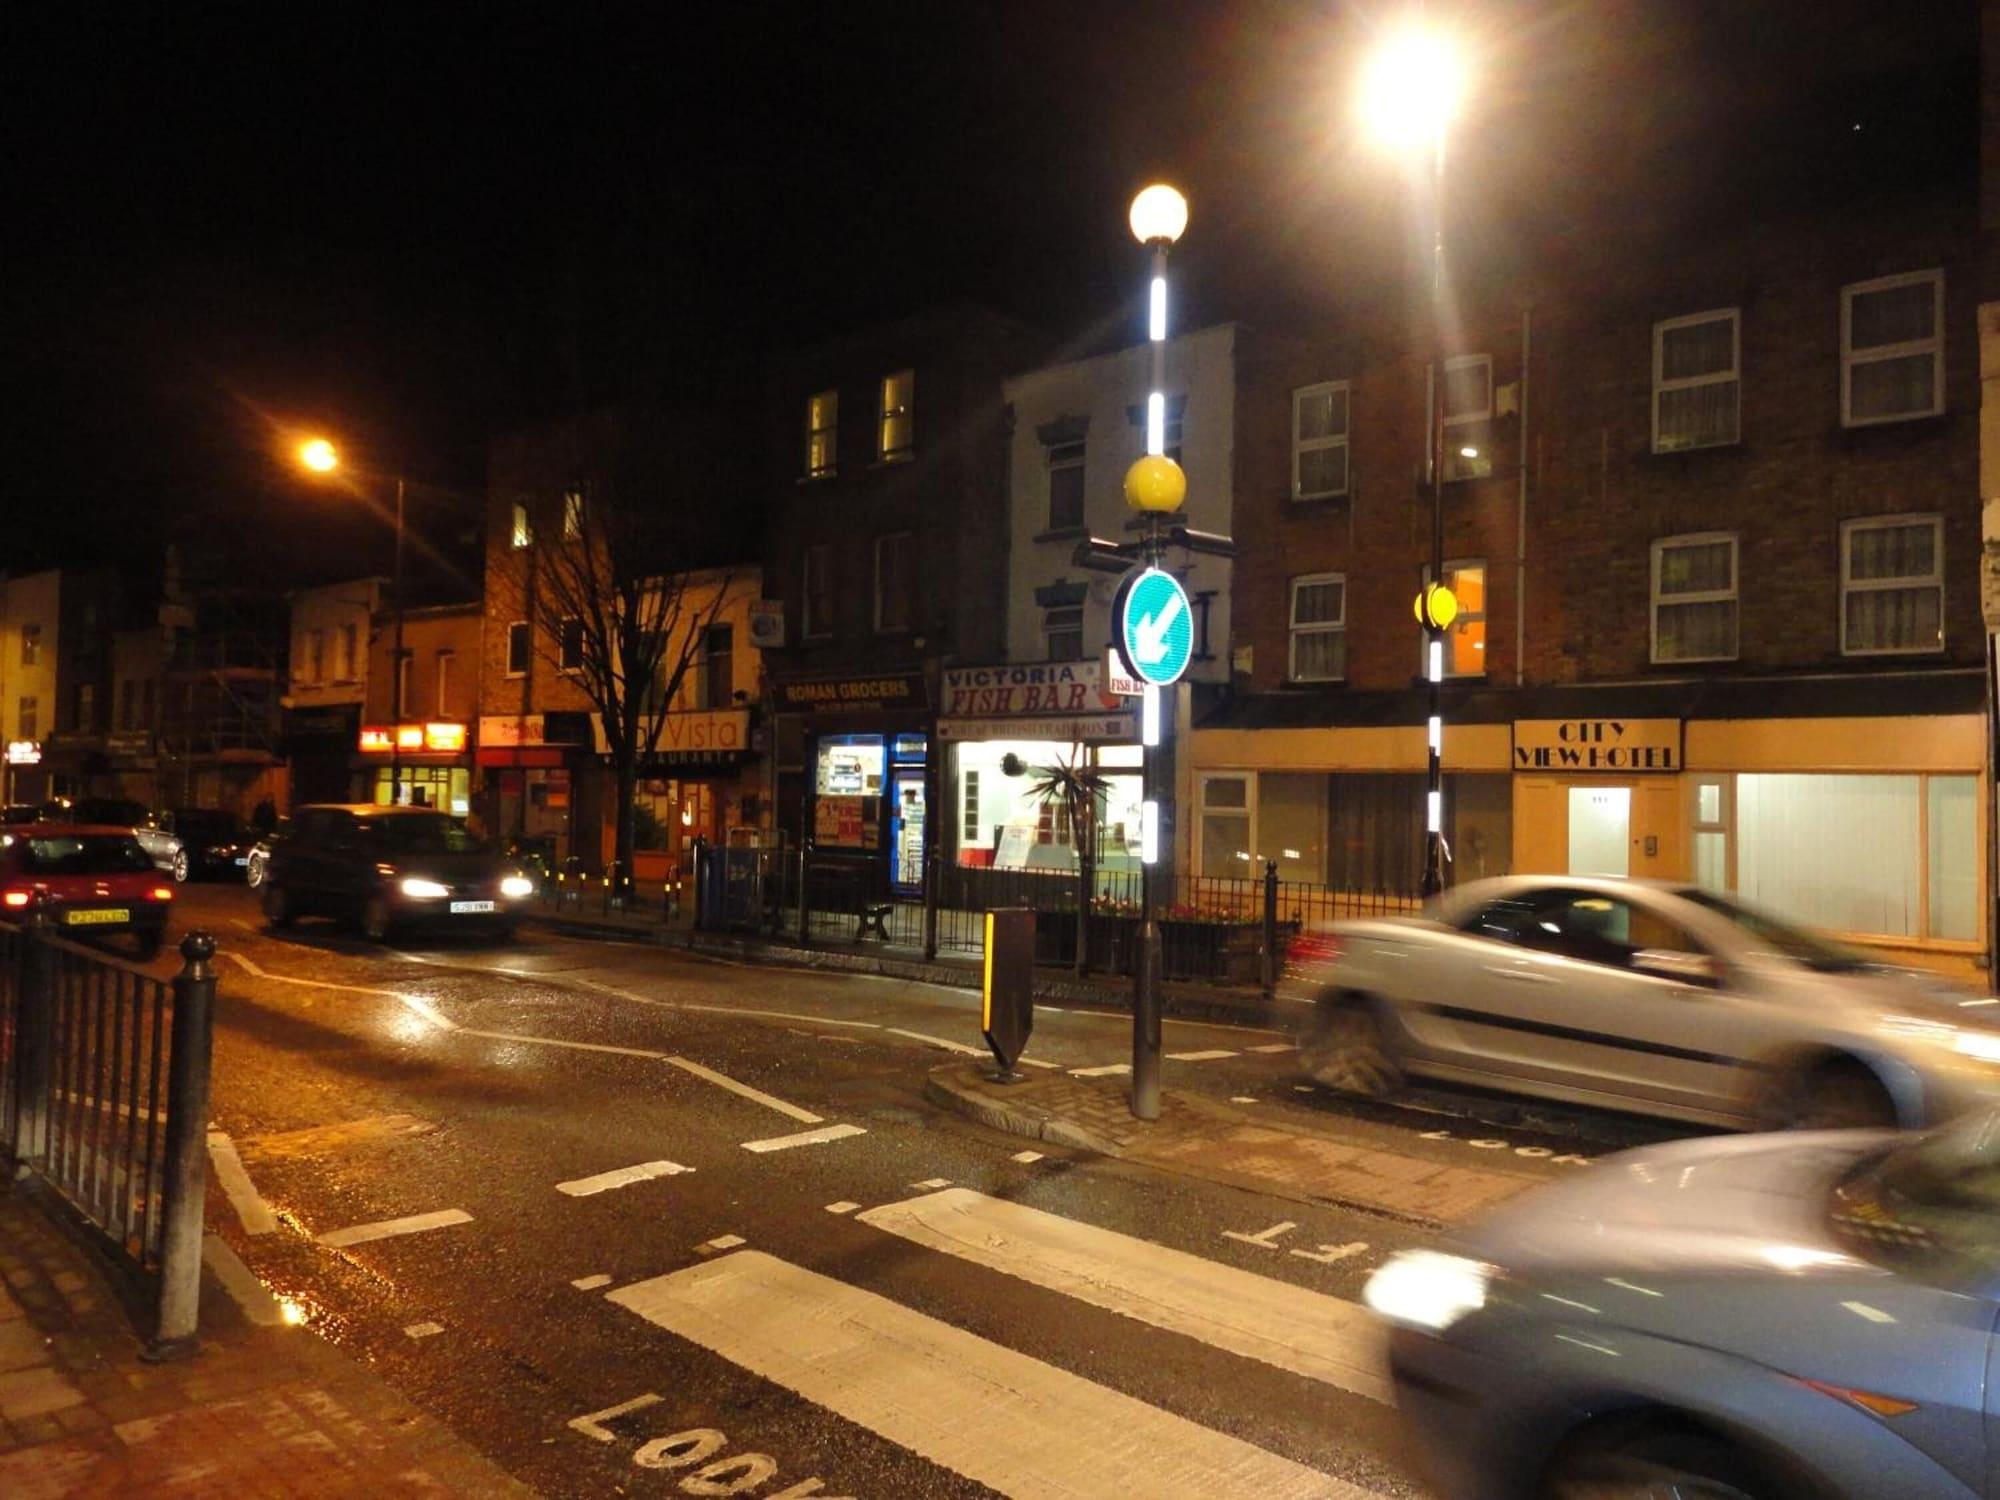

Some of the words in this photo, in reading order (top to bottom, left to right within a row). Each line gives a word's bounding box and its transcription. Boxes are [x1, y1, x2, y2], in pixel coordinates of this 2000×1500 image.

[948, 666, 1075, 687] VICTORIA
[1112, 678, 1131, 691] FISH
[786, 684, 836, 702] ROMAN
[840, 680, 909, 699] GROCERS
[948, 687, 1015, 716] FISH
[1022, 683, 1087, 711] BAR
[667, 713, 737, 747] Vista
[1558, 723, 1625, 743] CITY
[1516, 747, 1585, 767] VIEW
[1589, 747, 1673, 768] HOTEL
